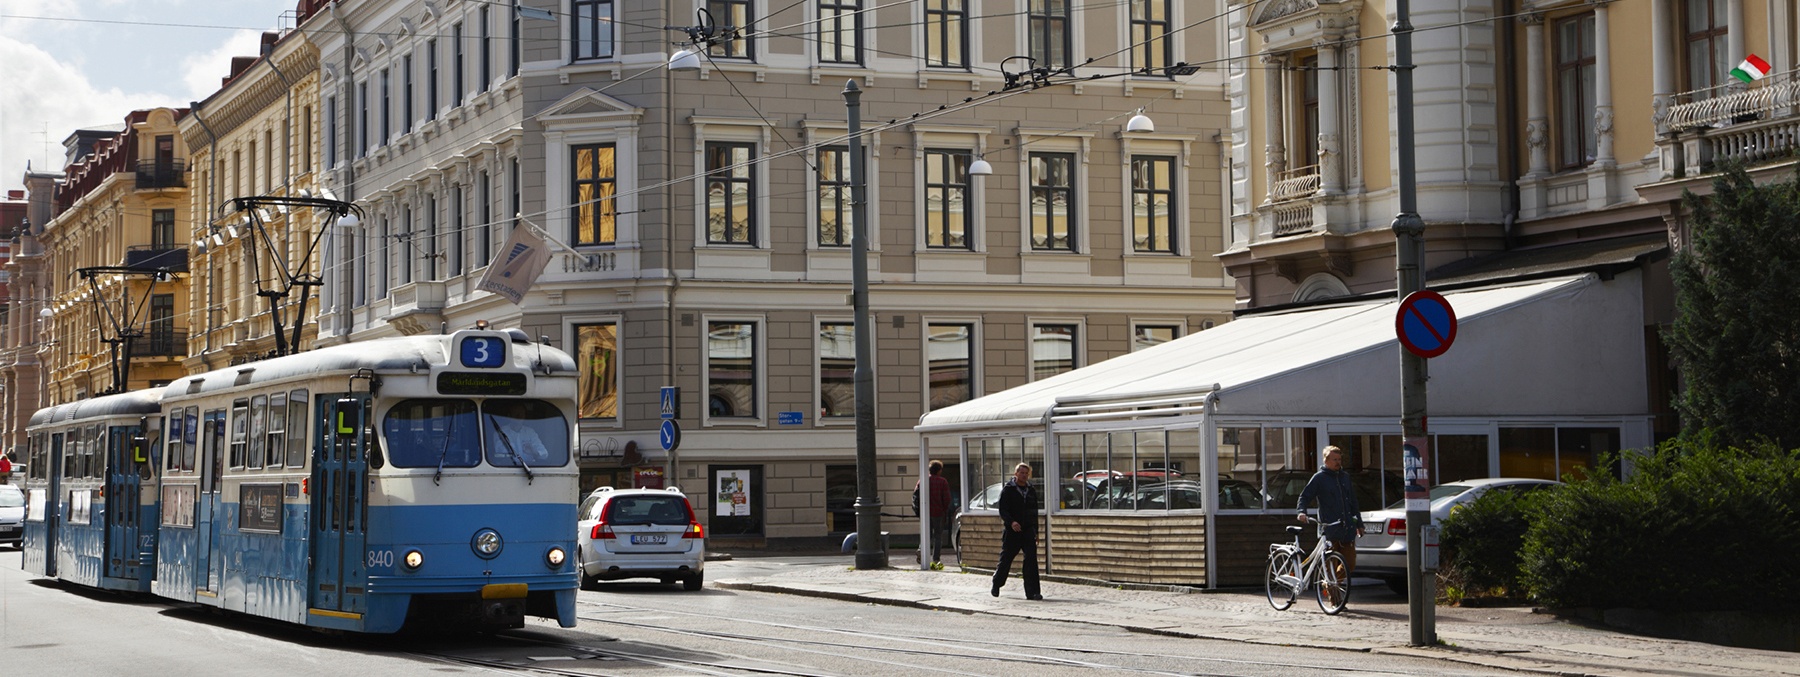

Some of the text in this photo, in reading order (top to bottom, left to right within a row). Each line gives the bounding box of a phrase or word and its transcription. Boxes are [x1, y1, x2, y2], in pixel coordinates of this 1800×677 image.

[473, 338, 489, 363] 3
[338, 411, 354, 434] L
[135, 446, 147, 462] L
[635, 535, 666, 543] LEU 577
[367, 550, 394, 568] 840
